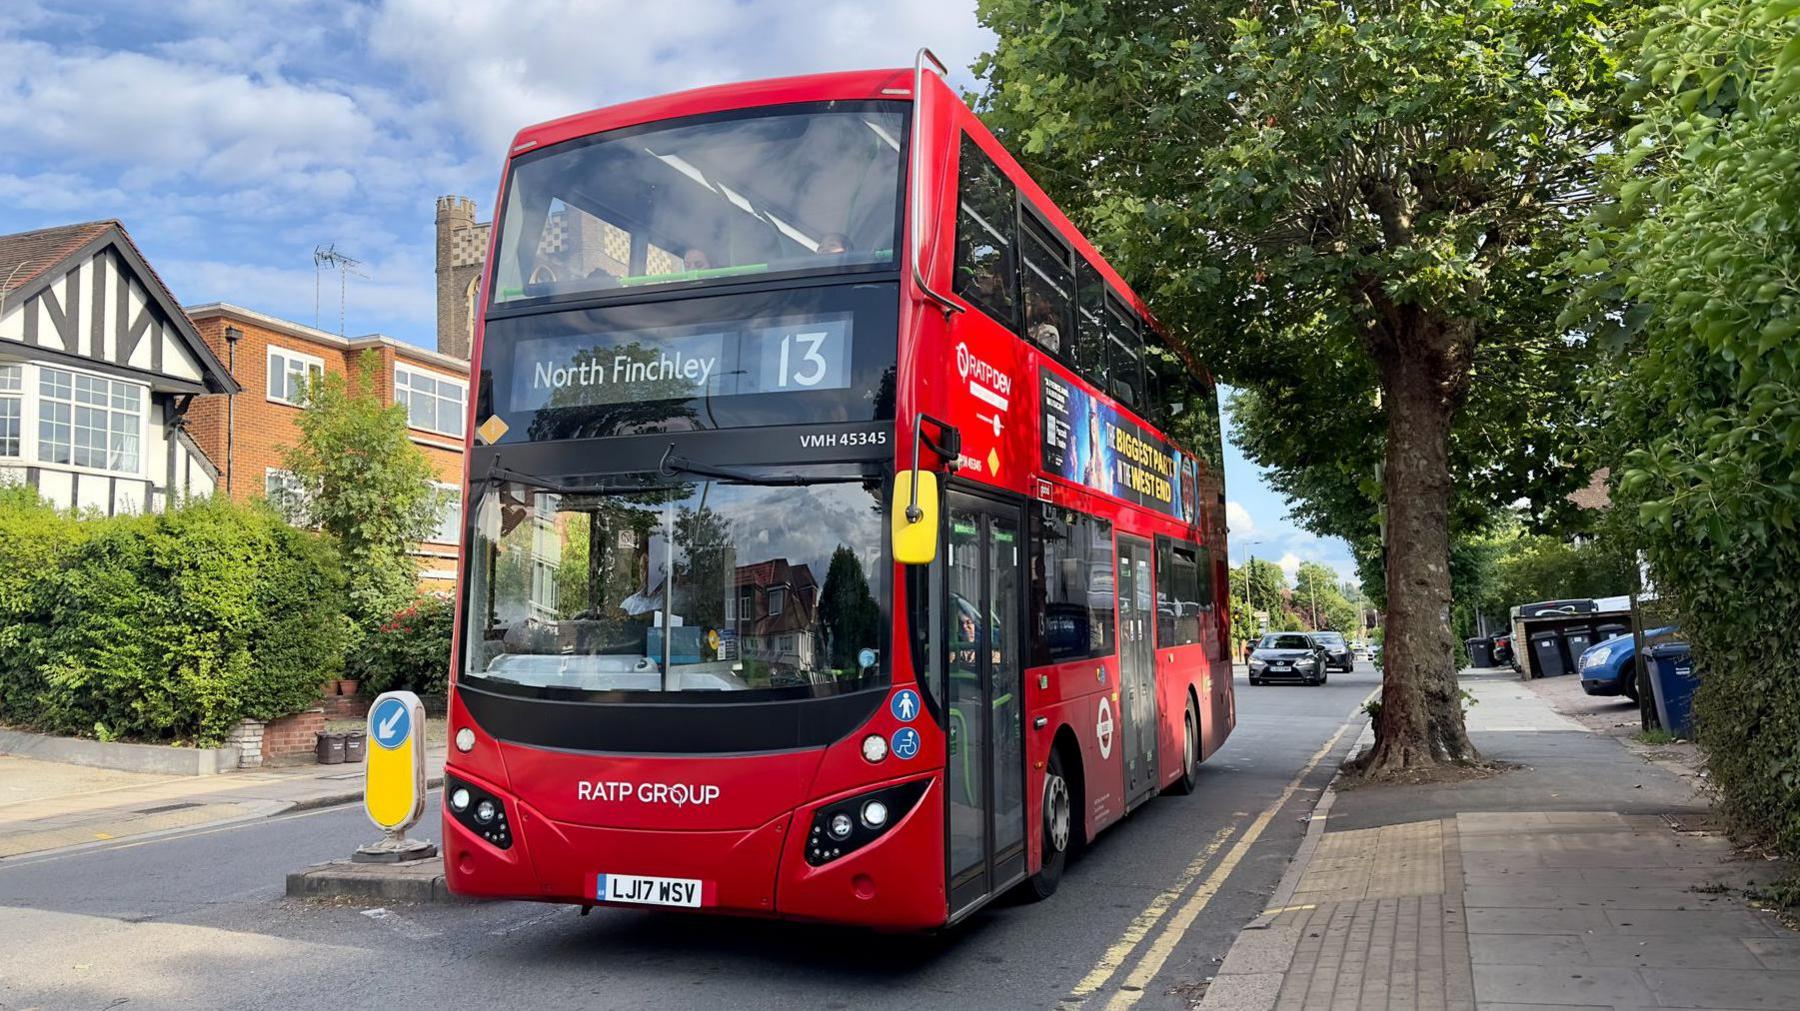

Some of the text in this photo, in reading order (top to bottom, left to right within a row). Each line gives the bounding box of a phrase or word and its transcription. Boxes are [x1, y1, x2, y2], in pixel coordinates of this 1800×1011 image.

[533, 351, 715, 389] North Finchley
[778, 332, 828, 387] 13
[800, 431, 886, 448] VMH 45345
[1116, 427, 1153, 468] BIGGEST
[1131, 465, 1155, 497] WEST
[1155, 477, 1172, 503] END
[578, 781, 720, 808] RATP GROUP
[613, 878, 695, 903] LJ17 WSV
